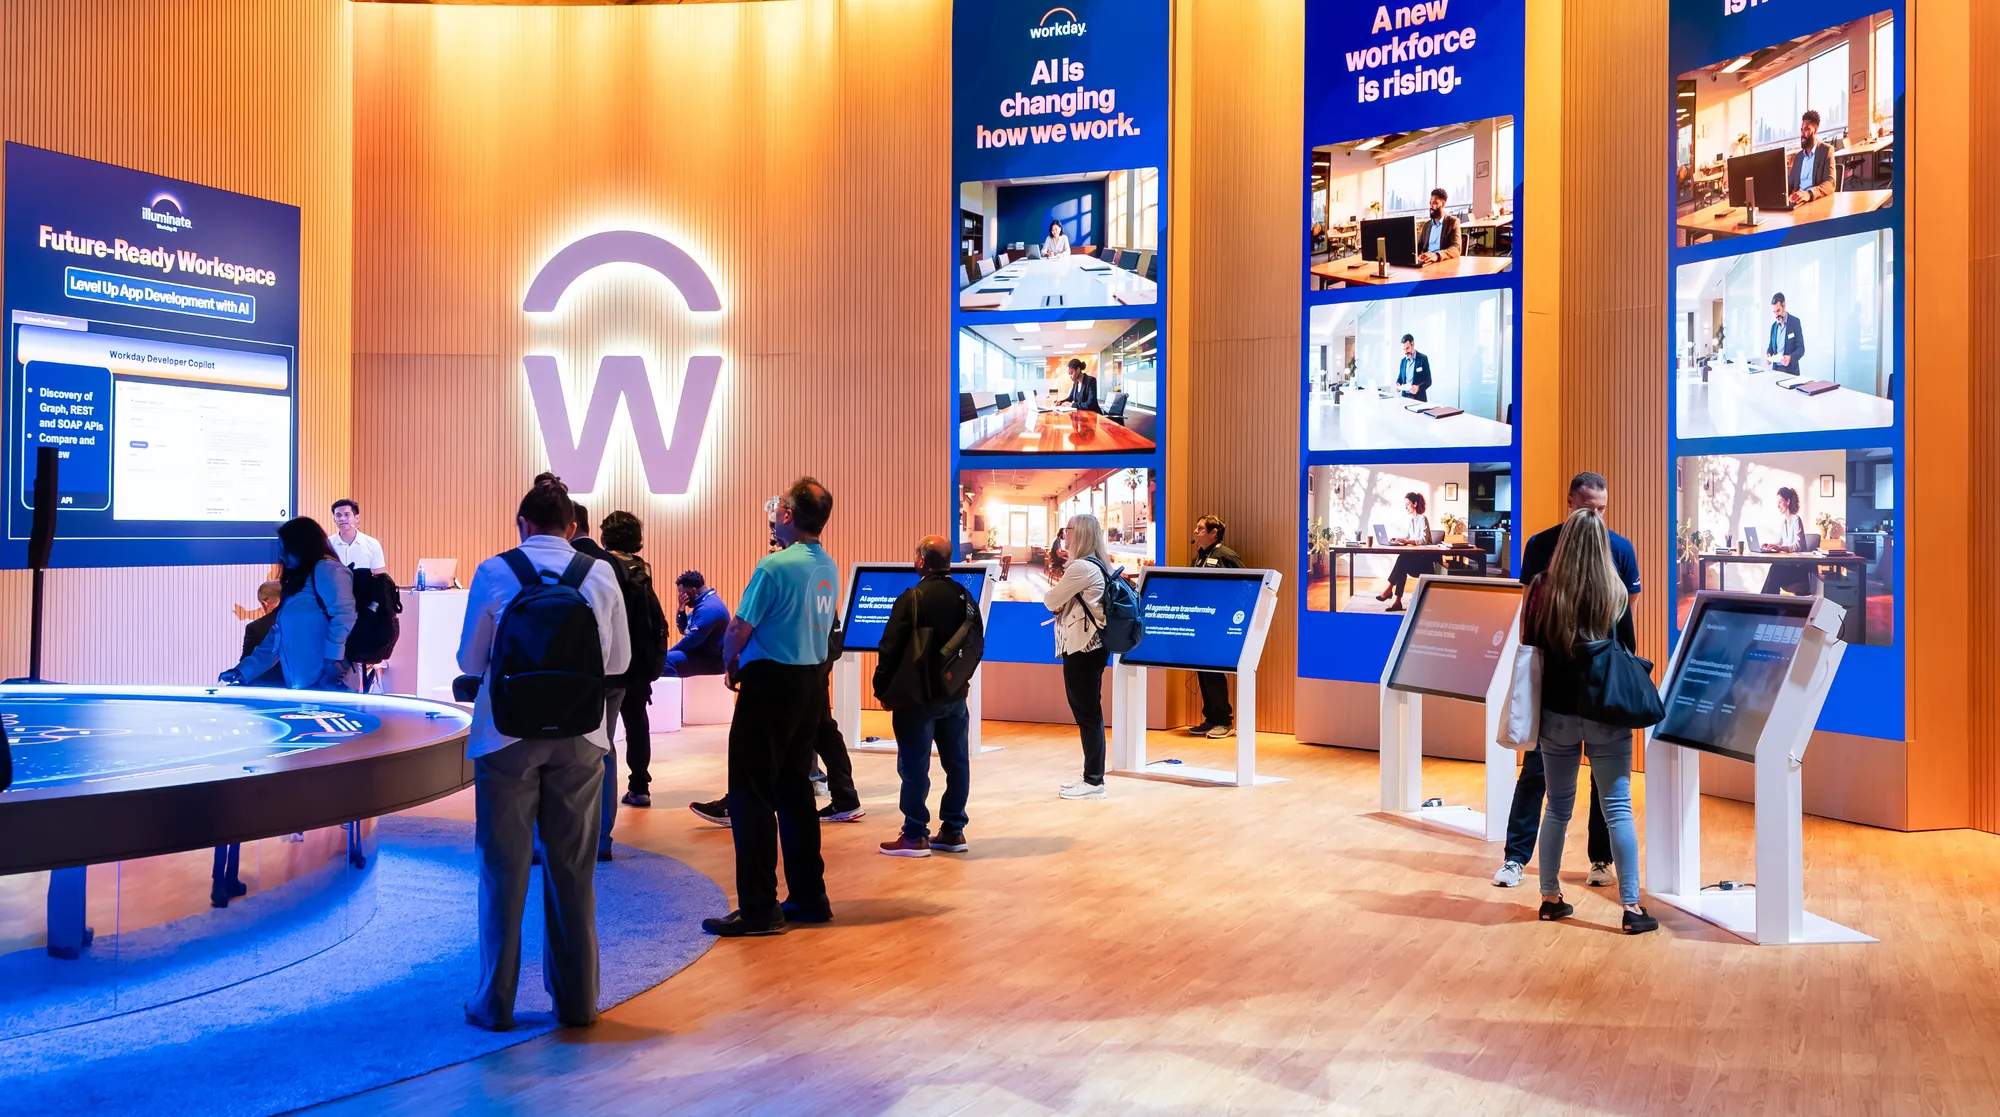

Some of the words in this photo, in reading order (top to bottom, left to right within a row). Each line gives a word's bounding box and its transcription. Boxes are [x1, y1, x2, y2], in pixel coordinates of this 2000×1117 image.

[1030, 21, 1086, 38] workday.
[1372, 6, 1392, 34] A
[1395, 0, 1448, 29] new
[1346, 27, 1476, 72] workforce
[1030, 58, 1058, 85] AI
[1062, 58, 1084, 82] is
[1358, 76, 1380, 103] is
[1383, 65, 1462, 98] rising.
[1000, 86, 1115, 118] changing
[977, 125, 1028, 148] how
[1030, 122, 1066, 144] we
[1070, 112, 1140, 141] work.
[40, 224, 175, 273] Future-Ready
[177, 250, 276, 286] Workspace
[70, 276, 101, 294] Level
[102, 281, 119, 298] Up
[120, 284, 143, 302] App
[144, 288, 215, 310] Development
[216, 300, 238, 314] with
[238, 302, 250, 315] AI
[110, 350, 145, 363] Workday
[147, 354, 186, 366] Developer
[188, 359, 215, 369] Copilot
[40, 388, 82, 402] Discovery
[84, 392, 93, 401] of
[40, 402, 68, 415] Graph,
[70, 405, 94, 415] REST
[39, 419, 56, 428] and
[58, 420, 83, 429] SOAP
[84, 421, 104, 431] APIs
[39, 433, 78, 445] Compare
[79, 436, 95, 445] and
[523, 356, 722, 494] W
